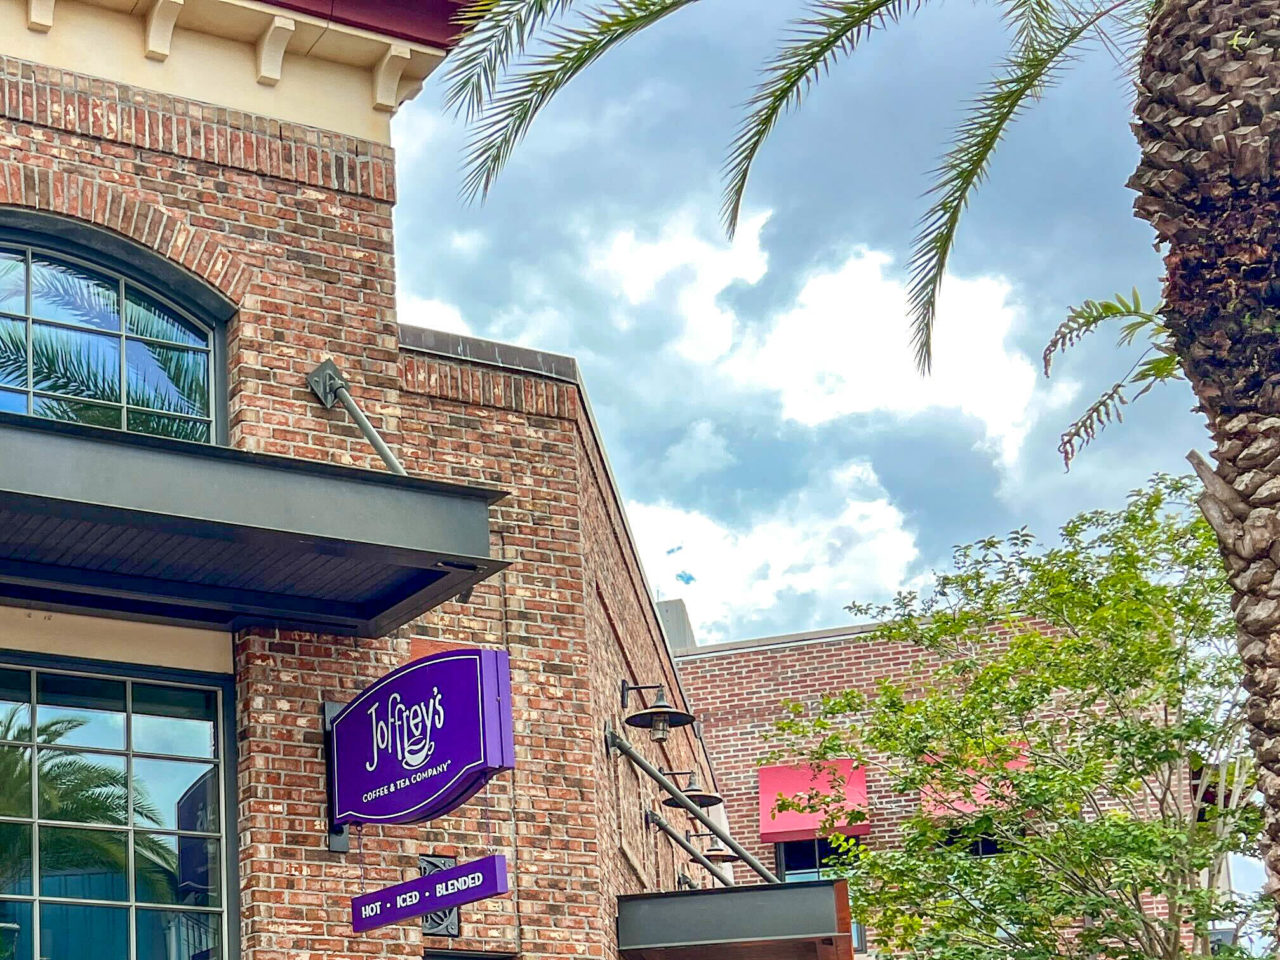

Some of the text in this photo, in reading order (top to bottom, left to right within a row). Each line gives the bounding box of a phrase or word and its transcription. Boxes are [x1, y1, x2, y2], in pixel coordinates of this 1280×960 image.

[365, 687, 444, 771] Joffrey's
[362, 763, 449, 802] COFFEE & TEA COMPANY
[361, 872, 484, 918] HOT ICED BLENDED
